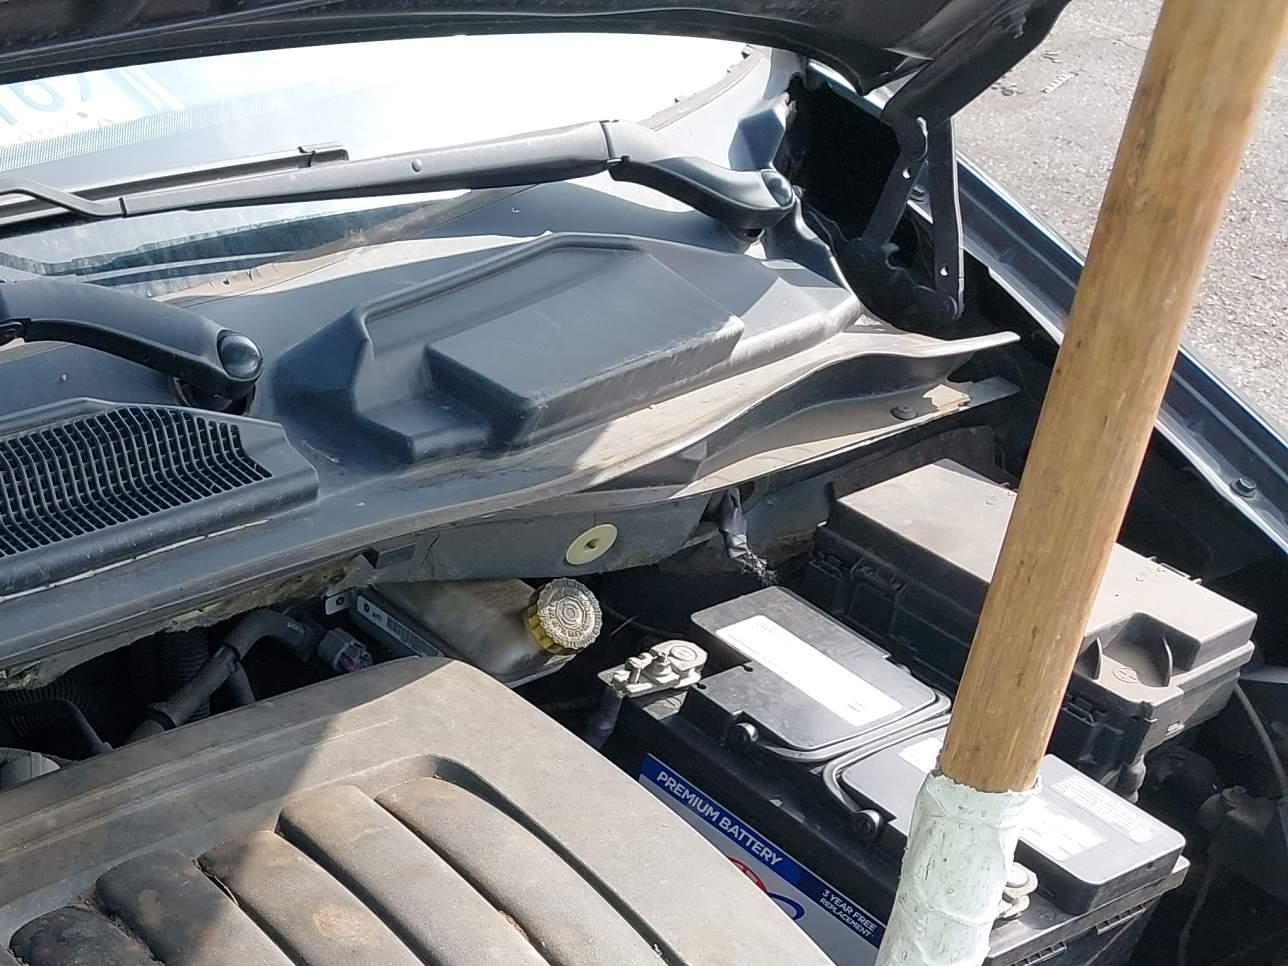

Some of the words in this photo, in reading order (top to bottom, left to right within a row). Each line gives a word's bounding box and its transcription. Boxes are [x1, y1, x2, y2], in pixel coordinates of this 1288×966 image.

[656, 771, 720, 821] PREMIUM
[718, 815, 782, 866] BATTERY
[820, 888, 831, 899] 3
[829, 894, 855, 915] YEAR
[852, 911, 877, 931] FREE
